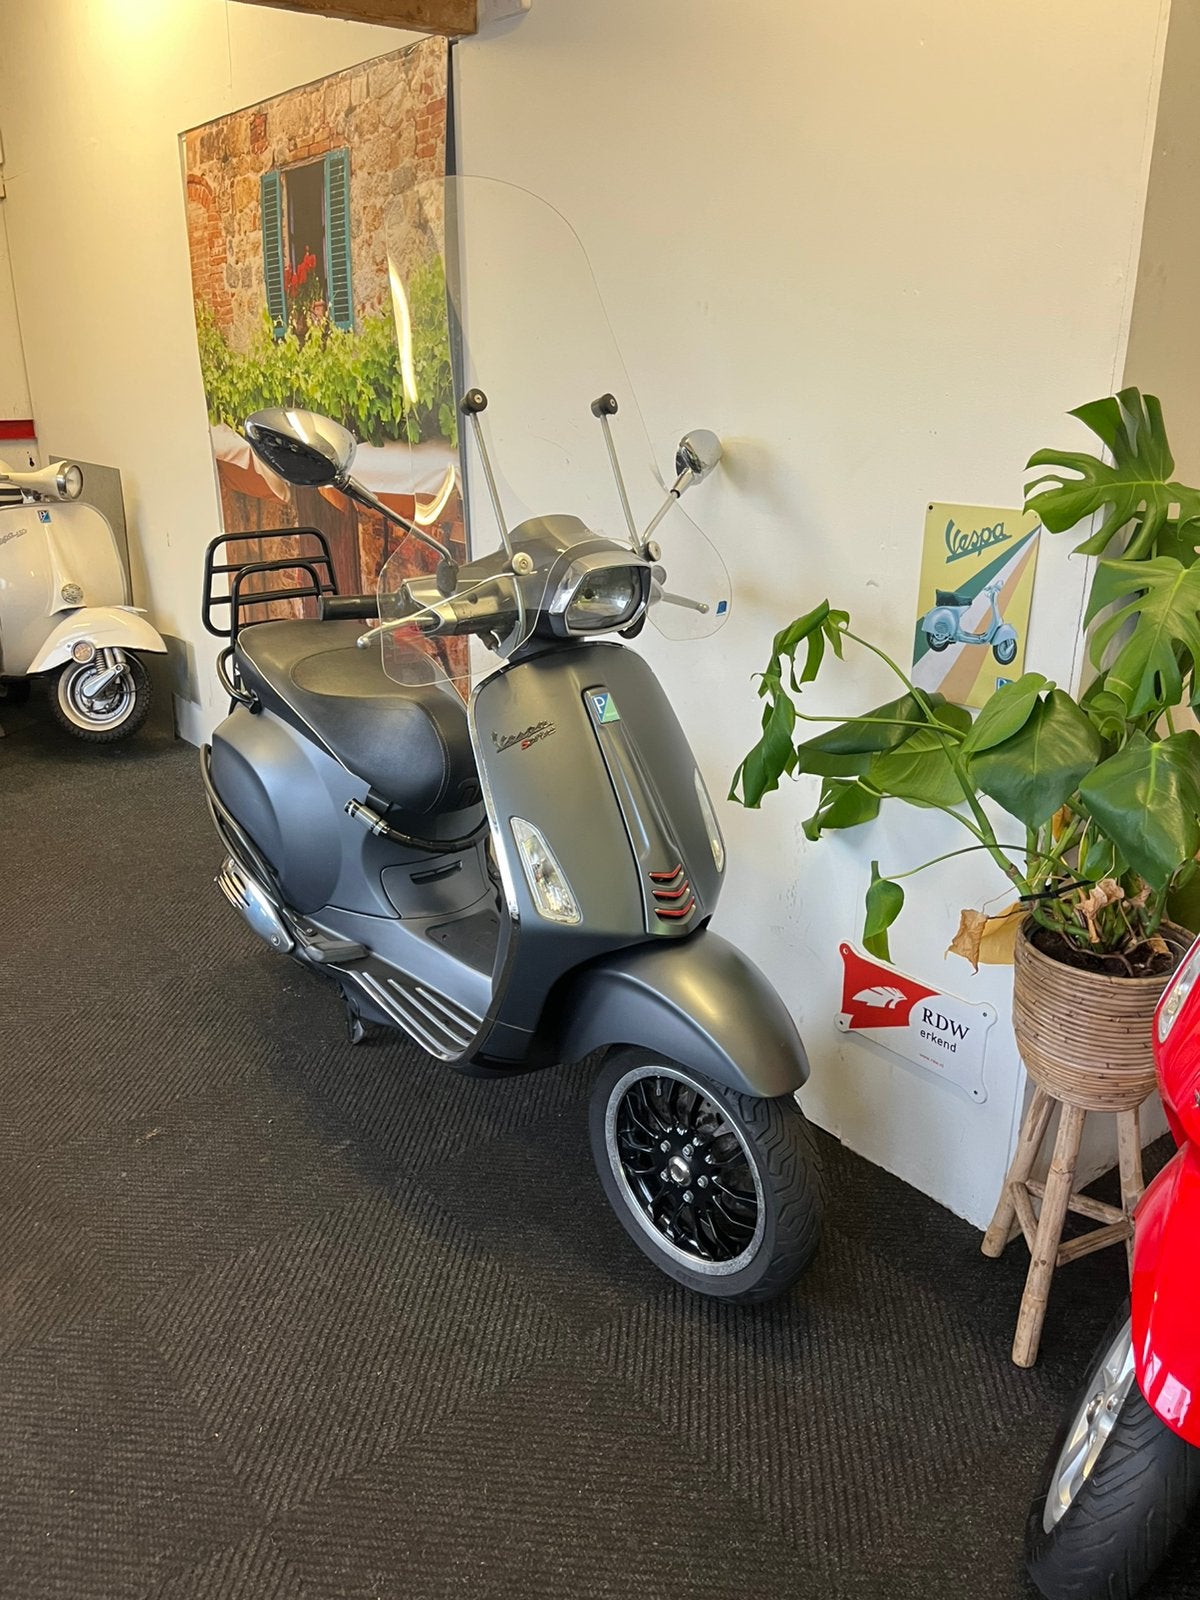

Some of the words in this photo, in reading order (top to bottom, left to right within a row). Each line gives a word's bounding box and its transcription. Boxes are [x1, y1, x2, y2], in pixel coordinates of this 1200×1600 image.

[945, 519, 1012, 563] Vespa
[922, 1007, 970, 1040] RDW
[920, 1029, 957, 1053] erkend
